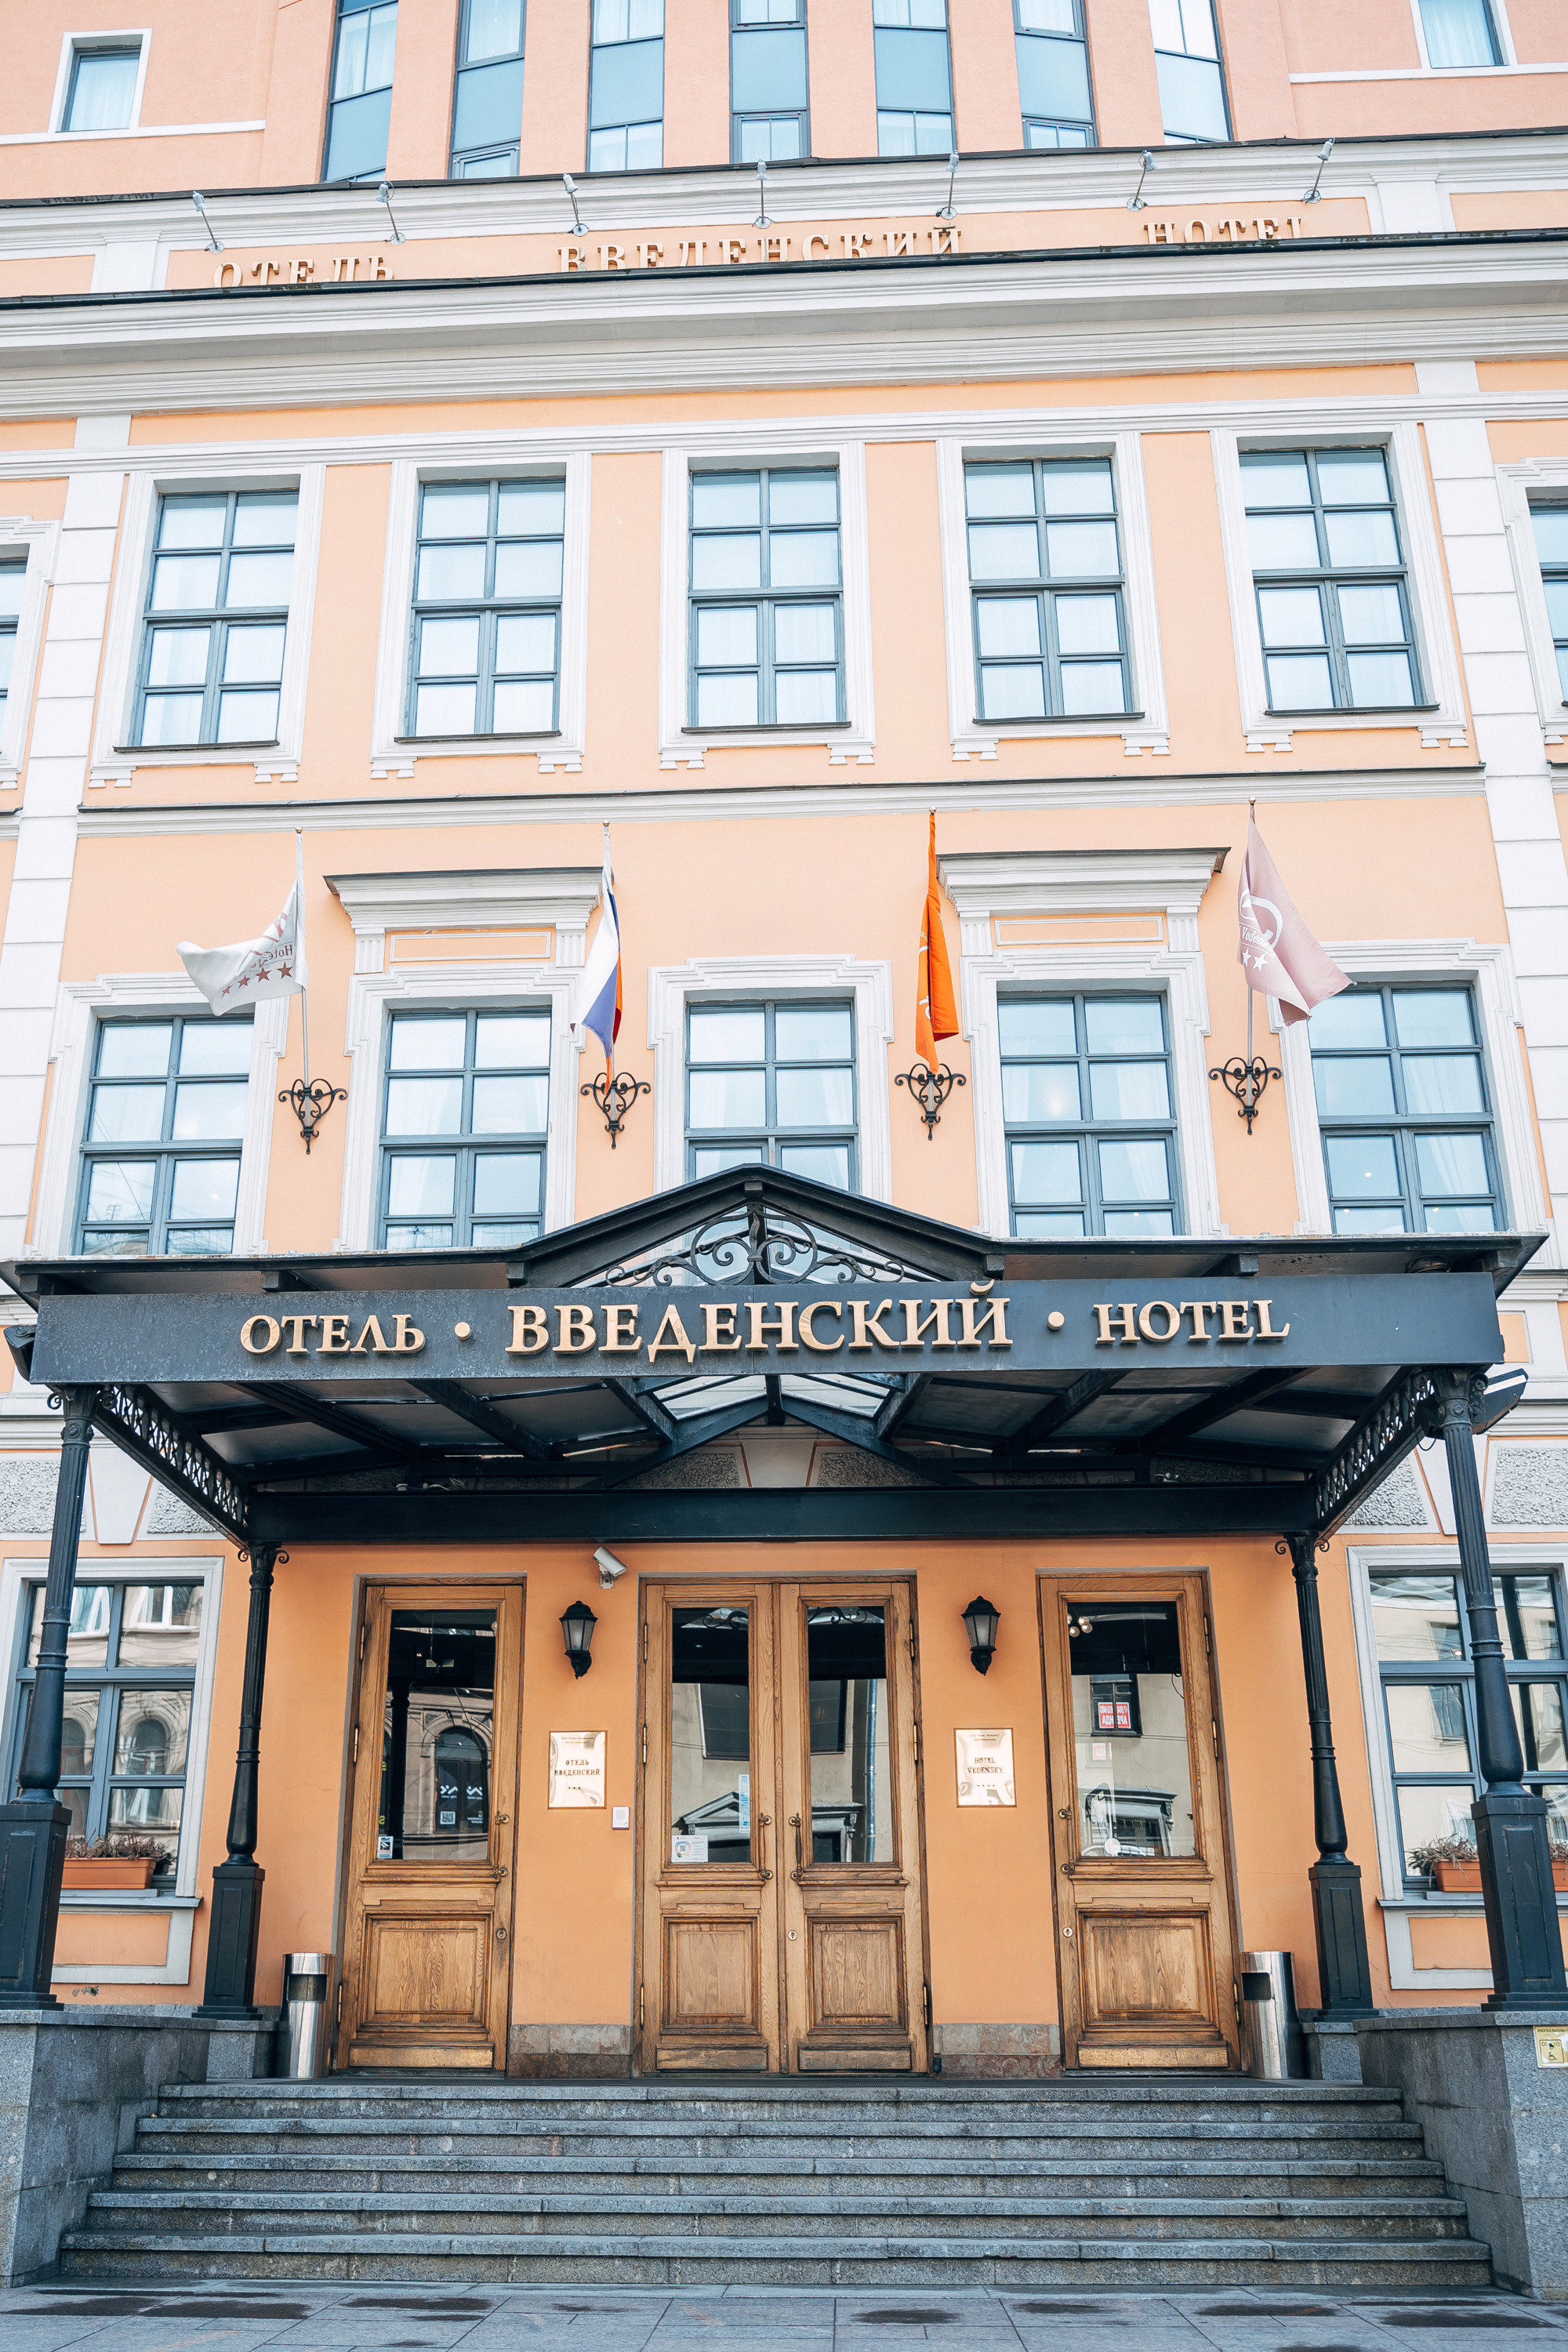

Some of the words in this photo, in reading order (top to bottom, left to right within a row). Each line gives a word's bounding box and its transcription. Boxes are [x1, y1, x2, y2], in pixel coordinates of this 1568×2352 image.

[212, 255, 394, 289] ОТЕЛЬ
[1143, 216, 1317, 245] HOTEL
[239, 1313, 426, 1356] ОТЕЛЬ
[504, 1279, 1014, 1364] ВВЕДЕНСКИЙ
[1093, 1300, 1290, 1345] HOTEL
